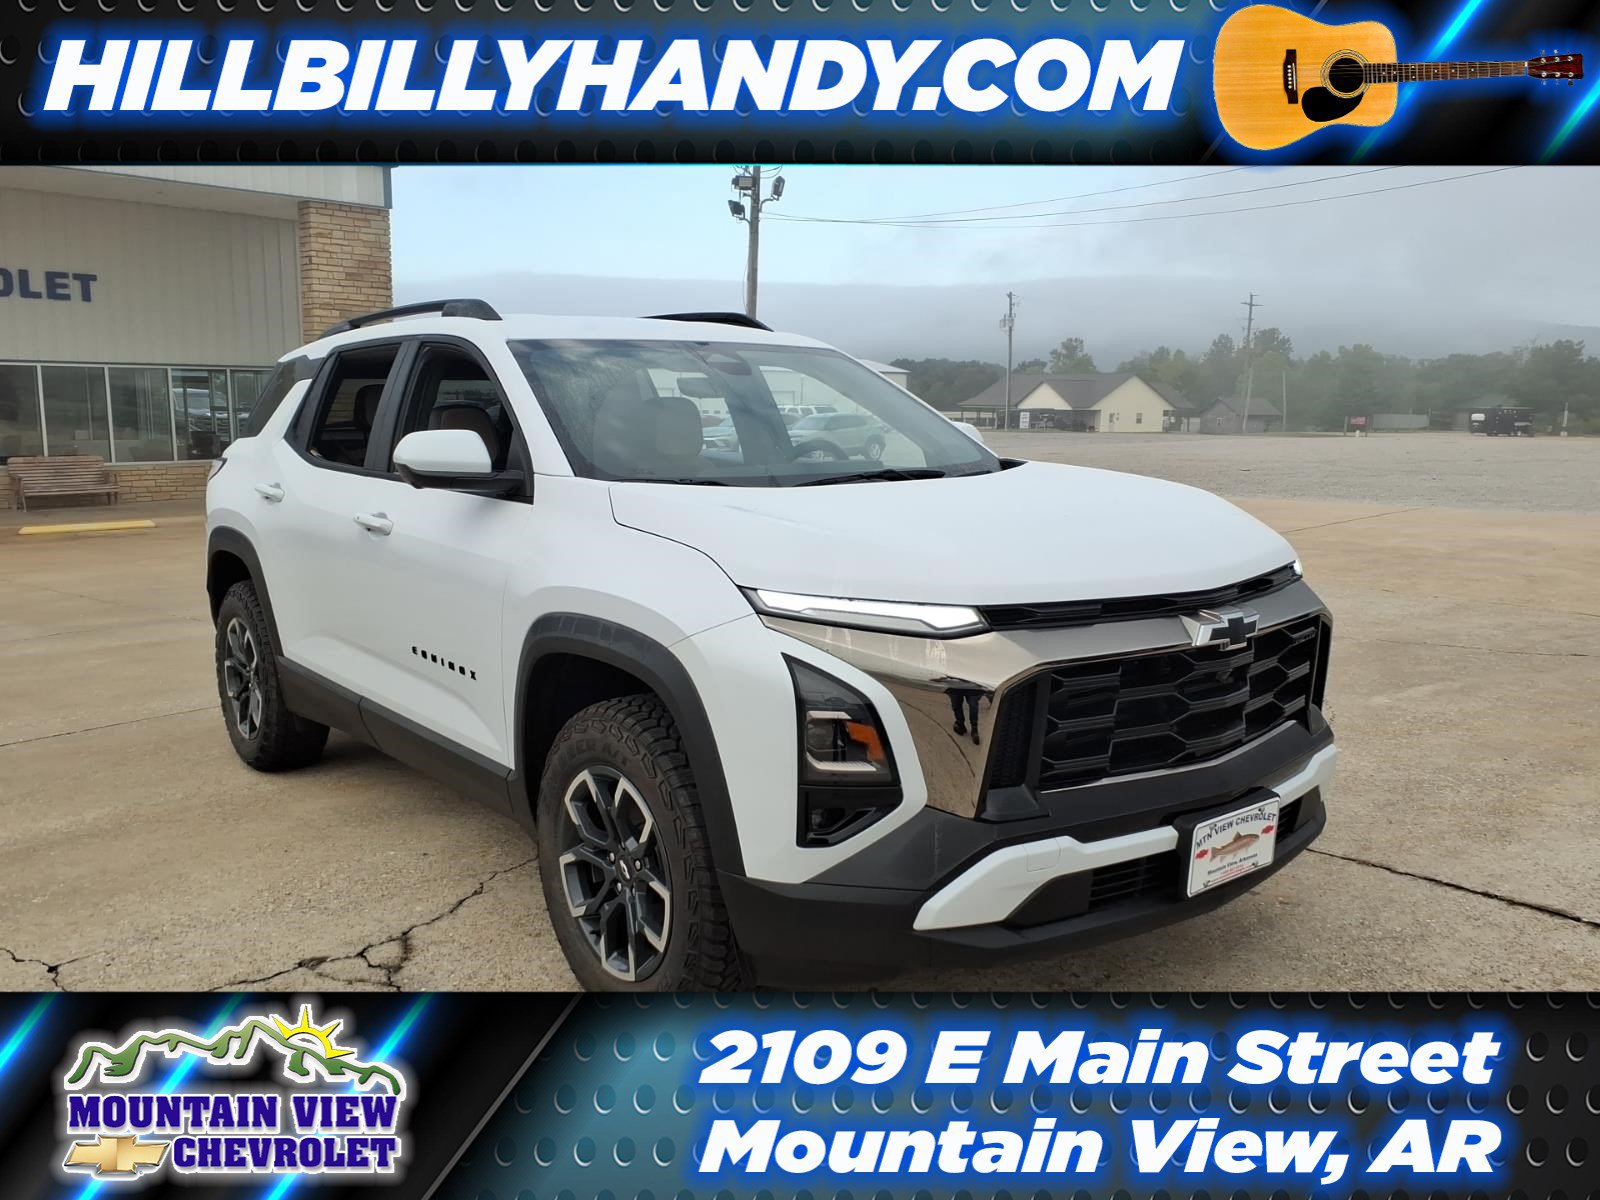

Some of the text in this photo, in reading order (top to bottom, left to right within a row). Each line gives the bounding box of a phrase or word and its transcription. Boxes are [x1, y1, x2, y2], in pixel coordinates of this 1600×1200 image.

[411, 645, 477, 681] EQUINOX
[1196, 812, 1277, 849] MTN VIEW CHEVROLET
